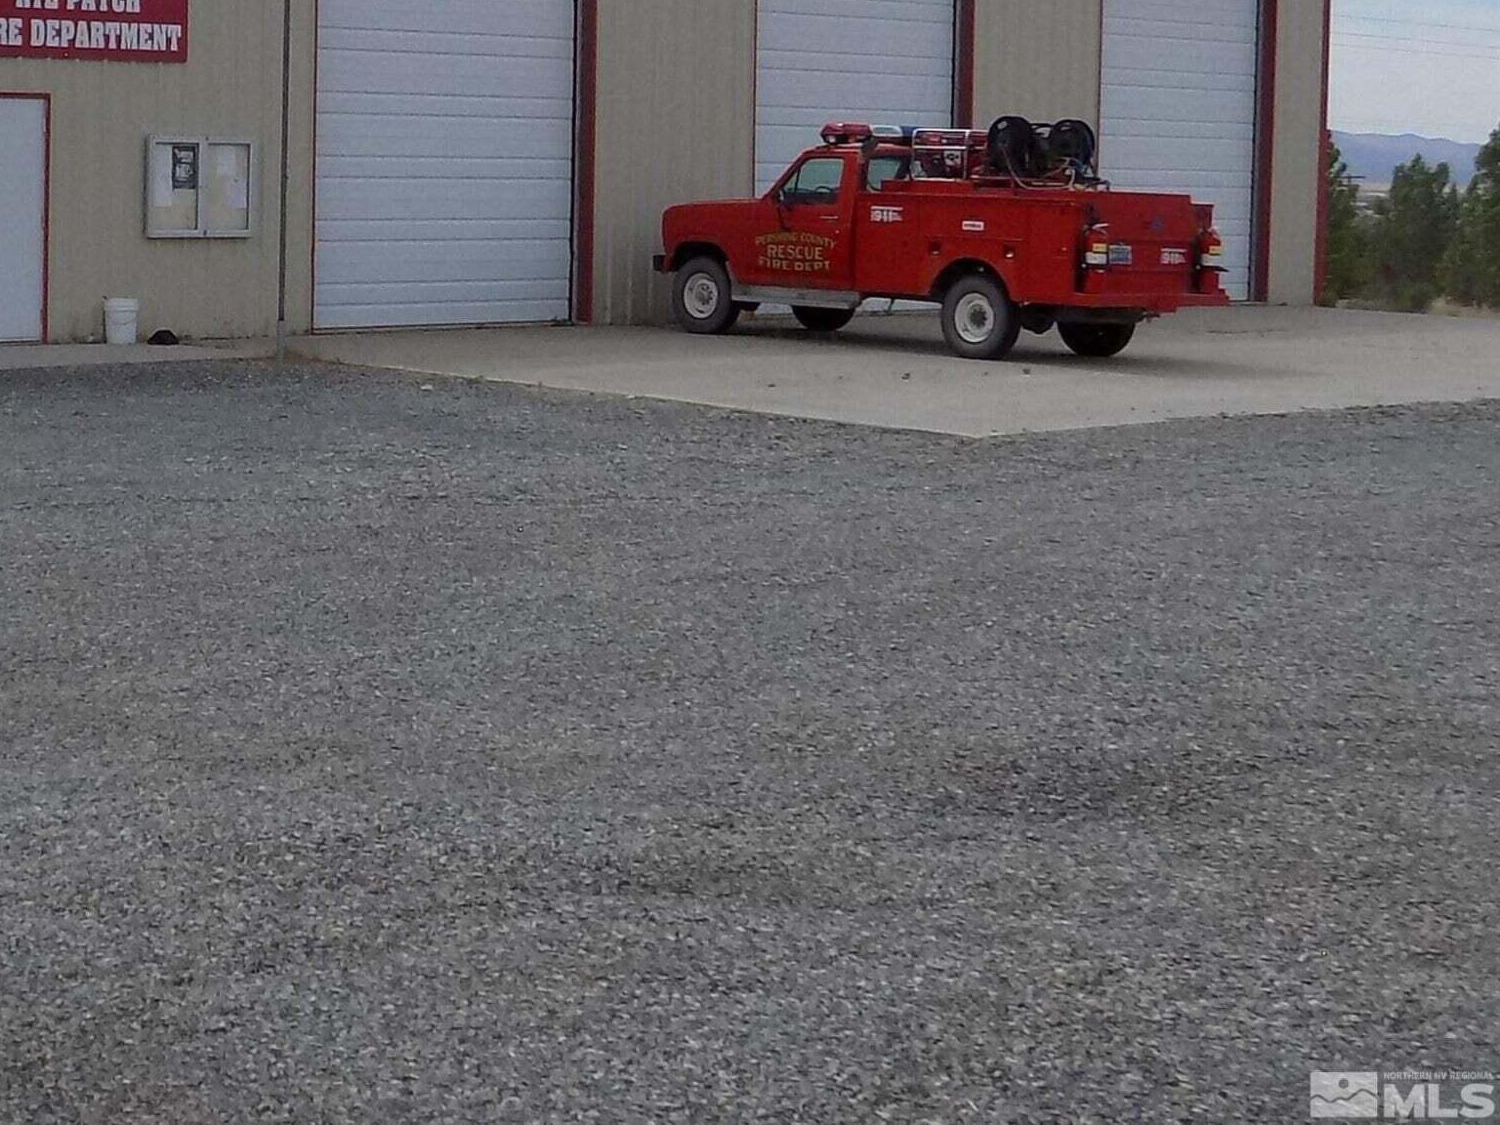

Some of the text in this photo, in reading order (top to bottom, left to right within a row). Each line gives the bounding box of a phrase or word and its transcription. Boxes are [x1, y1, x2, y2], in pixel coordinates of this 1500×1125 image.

[30, 19, 182, 51] DEPARTMENT
[767, 245, 824, 260] RESCUE
[758, 256, 830, 271] FIRE DEPT
